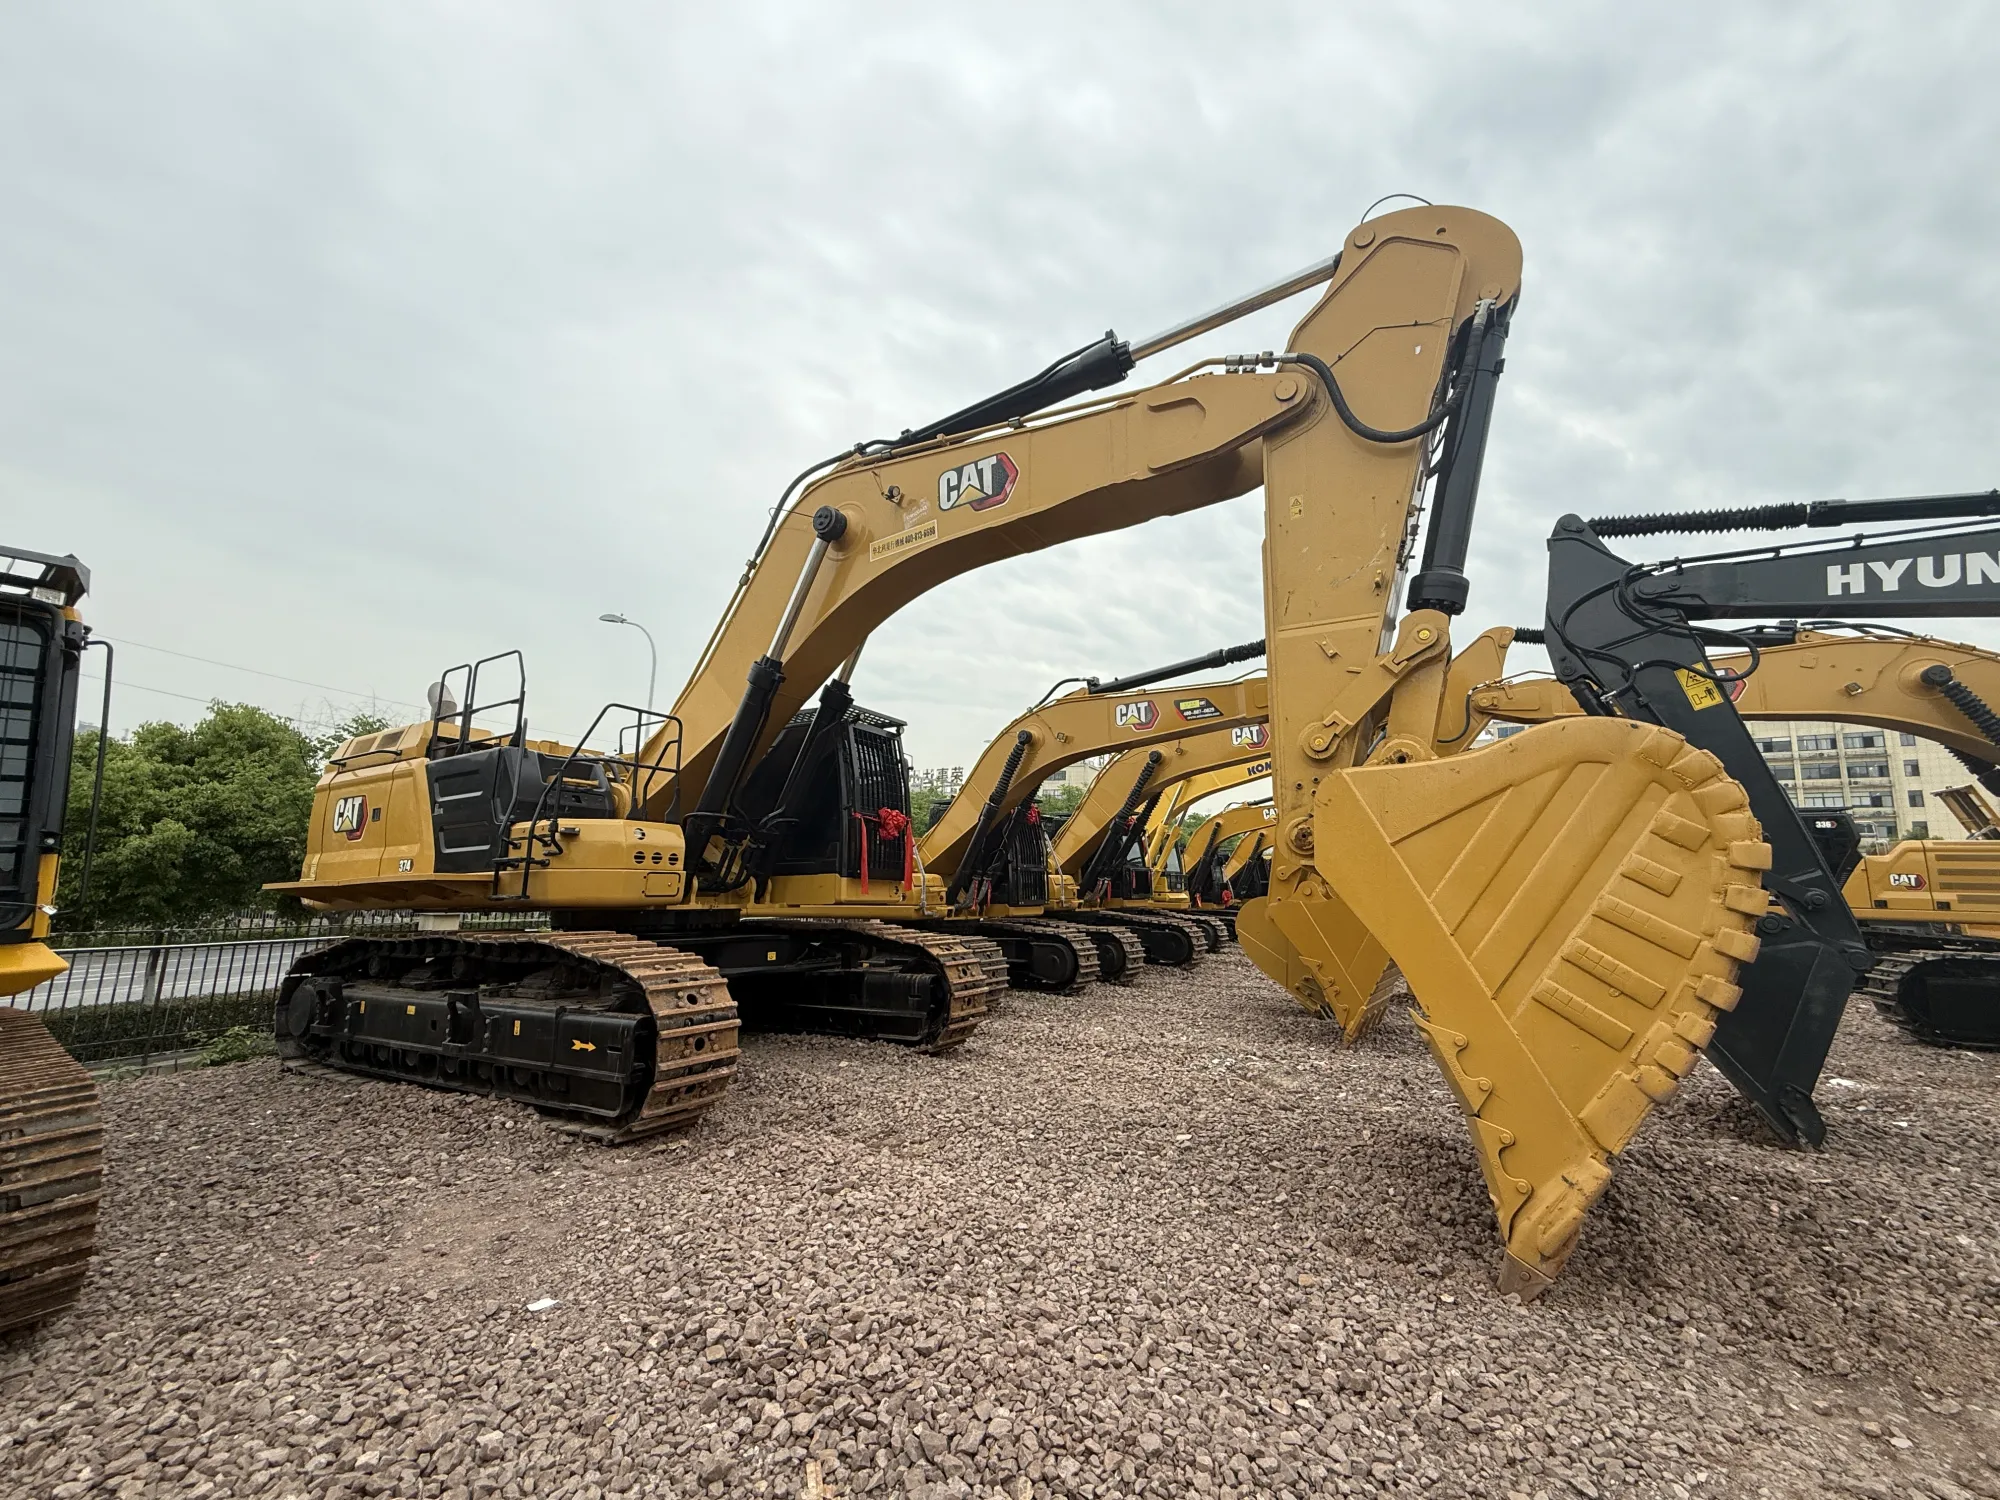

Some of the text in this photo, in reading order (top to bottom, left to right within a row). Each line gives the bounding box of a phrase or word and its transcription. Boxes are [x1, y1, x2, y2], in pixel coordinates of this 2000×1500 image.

[939, 455, 997, 510] CAT
[1115, 701, 1148, 726] CAT
[1231, 725, 1260, 746] CAT
[333, 796, 363, 832] CAT
[1815, 820, 1832, 829] 336
[398, 859, 411, 872] 374
[1889, 873, 1917, 887] CAT
